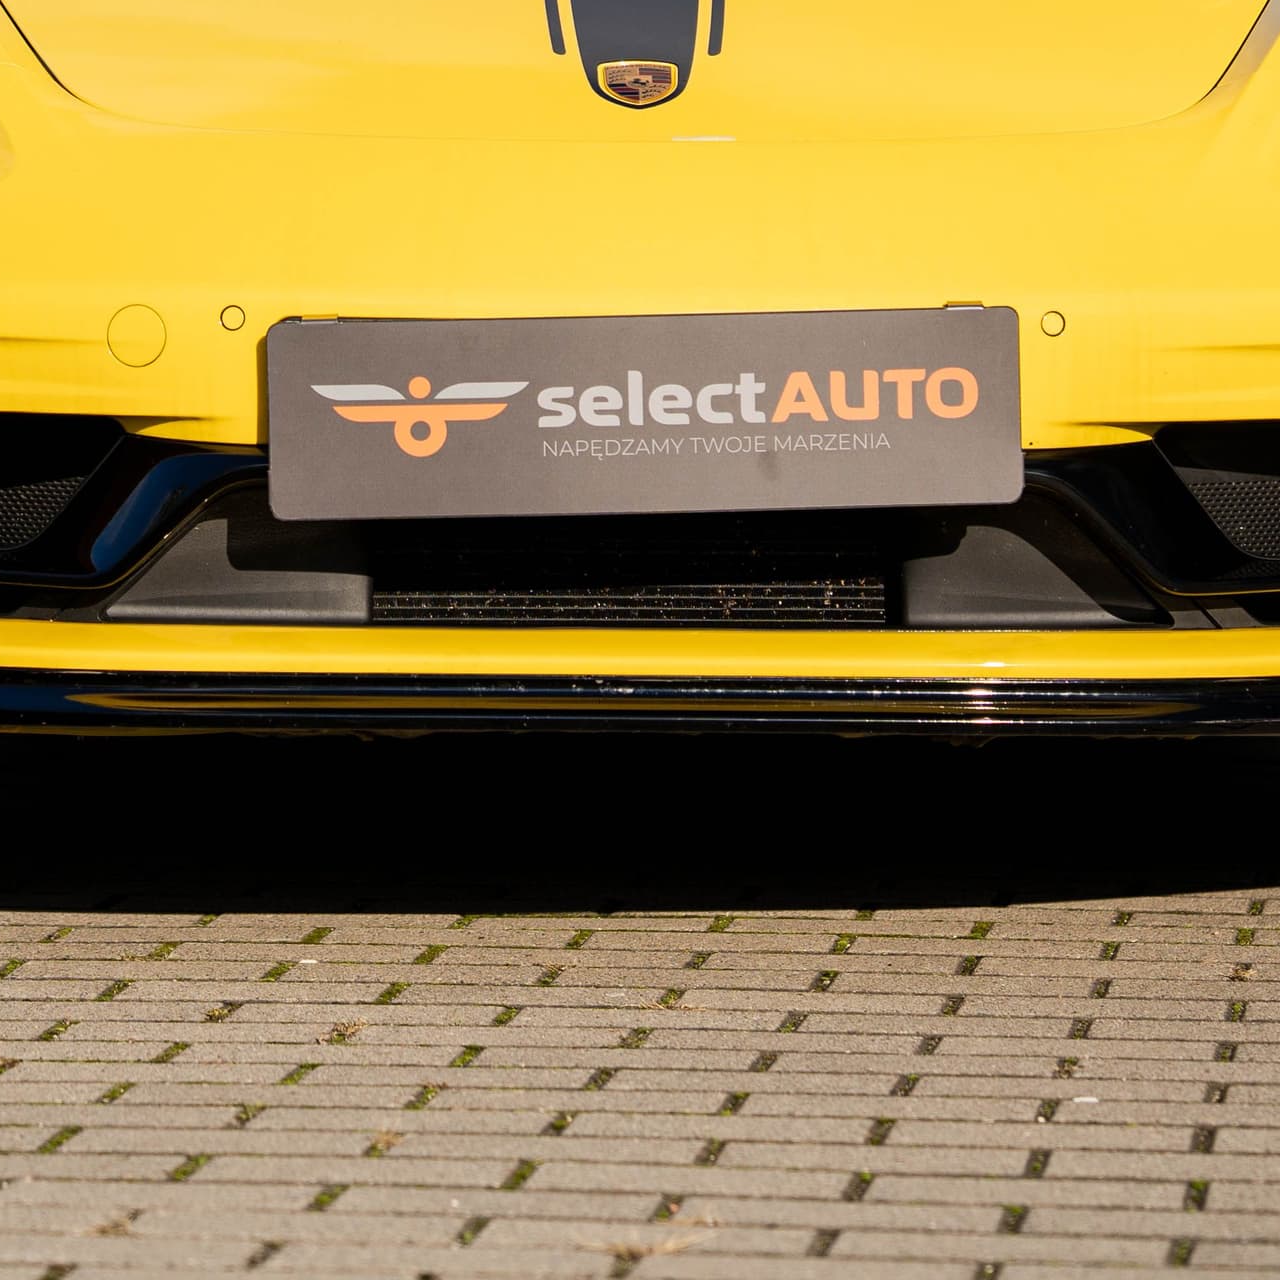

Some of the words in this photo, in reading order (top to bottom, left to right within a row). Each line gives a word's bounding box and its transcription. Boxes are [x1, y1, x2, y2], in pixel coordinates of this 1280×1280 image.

[536, 367, 979, 428] selectAUTO
[543, 439, 685, 461] NAPĘDZAMY
[688, 435, 768, 455] TWOJE
[774, 432, 892, 452] MARZENIA
